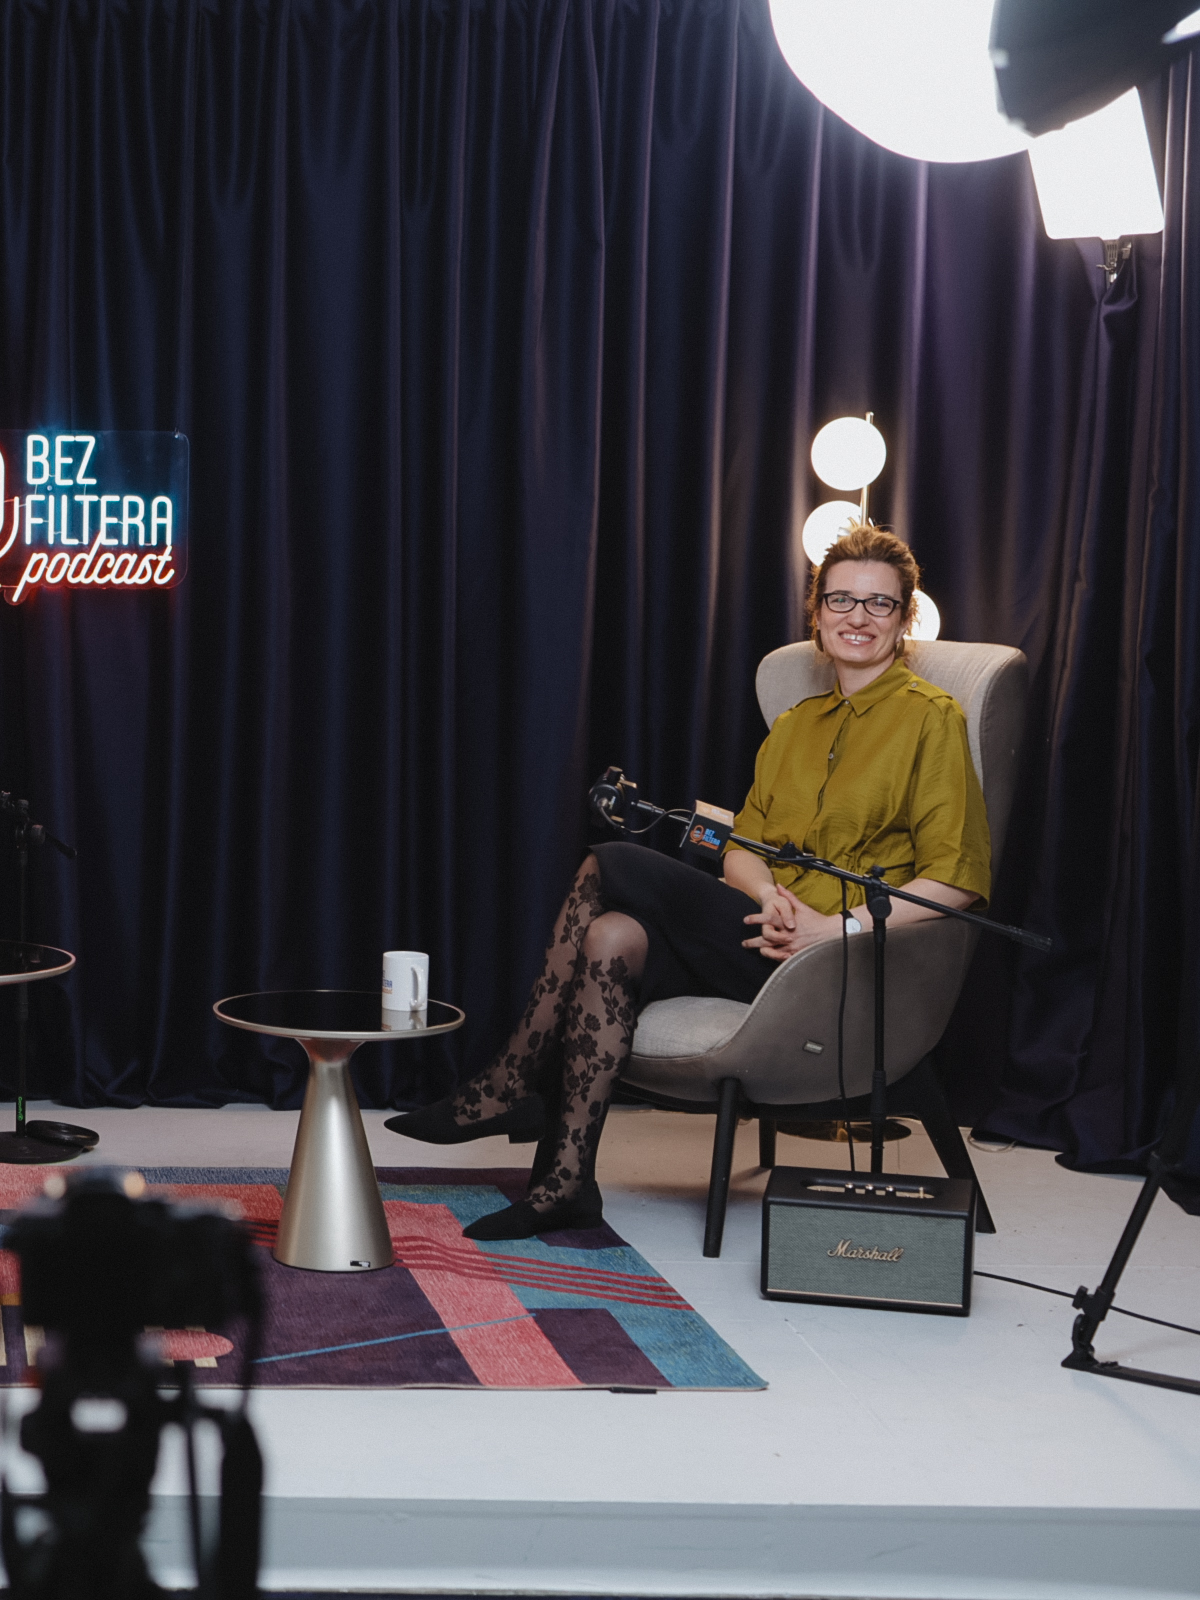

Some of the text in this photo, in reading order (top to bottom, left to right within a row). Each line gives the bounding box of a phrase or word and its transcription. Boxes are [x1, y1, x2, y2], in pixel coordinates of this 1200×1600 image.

[26, 434, 97, 486] BEZ
[25, 494, 173, 546] FILTERA
[12, 531, 175, 602] podcast
[827, 1239, 904, 1262] Marshall
